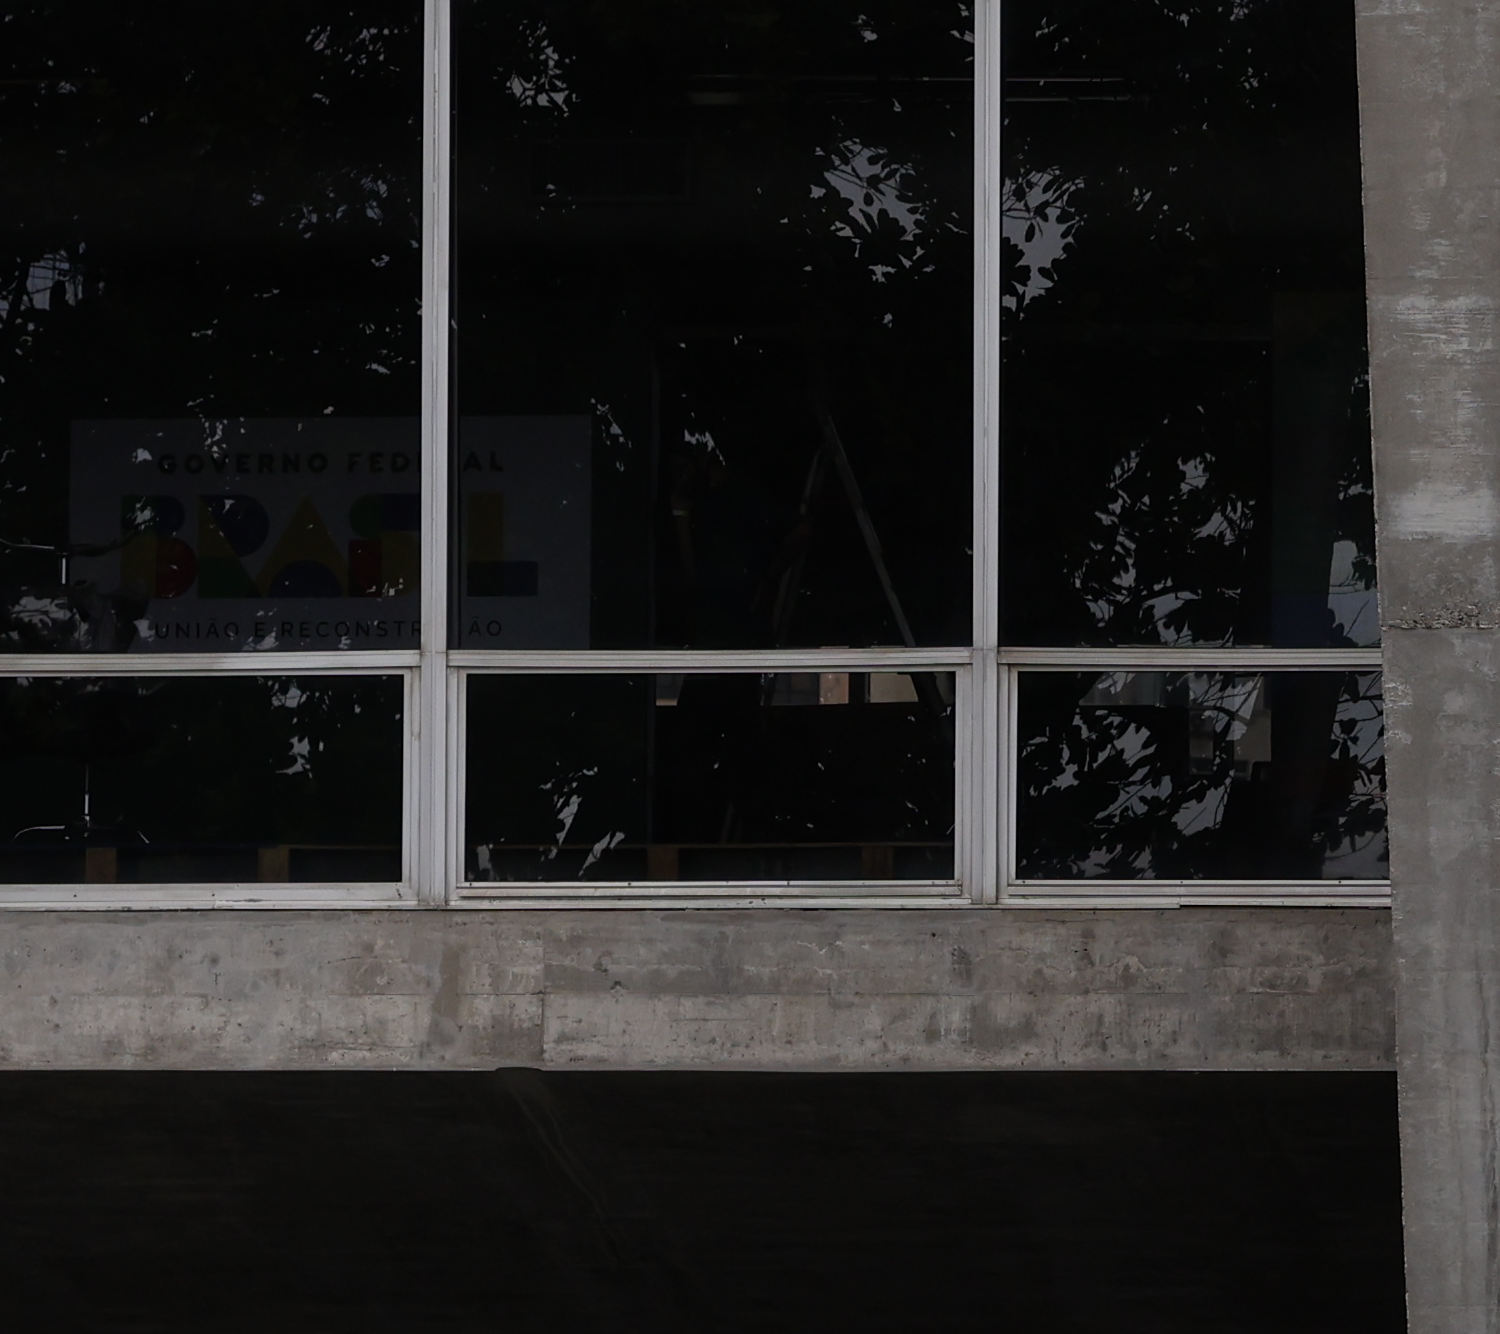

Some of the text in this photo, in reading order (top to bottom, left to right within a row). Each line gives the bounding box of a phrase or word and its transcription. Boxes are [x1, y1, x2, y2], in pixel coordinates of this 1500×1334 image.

[158, 451, 504, 474] GOVERNO FEDAL
[120, 492, 538, 599] BRASL
[155, 616, 502, 640] UNIÃO E RECONSTRÃO
